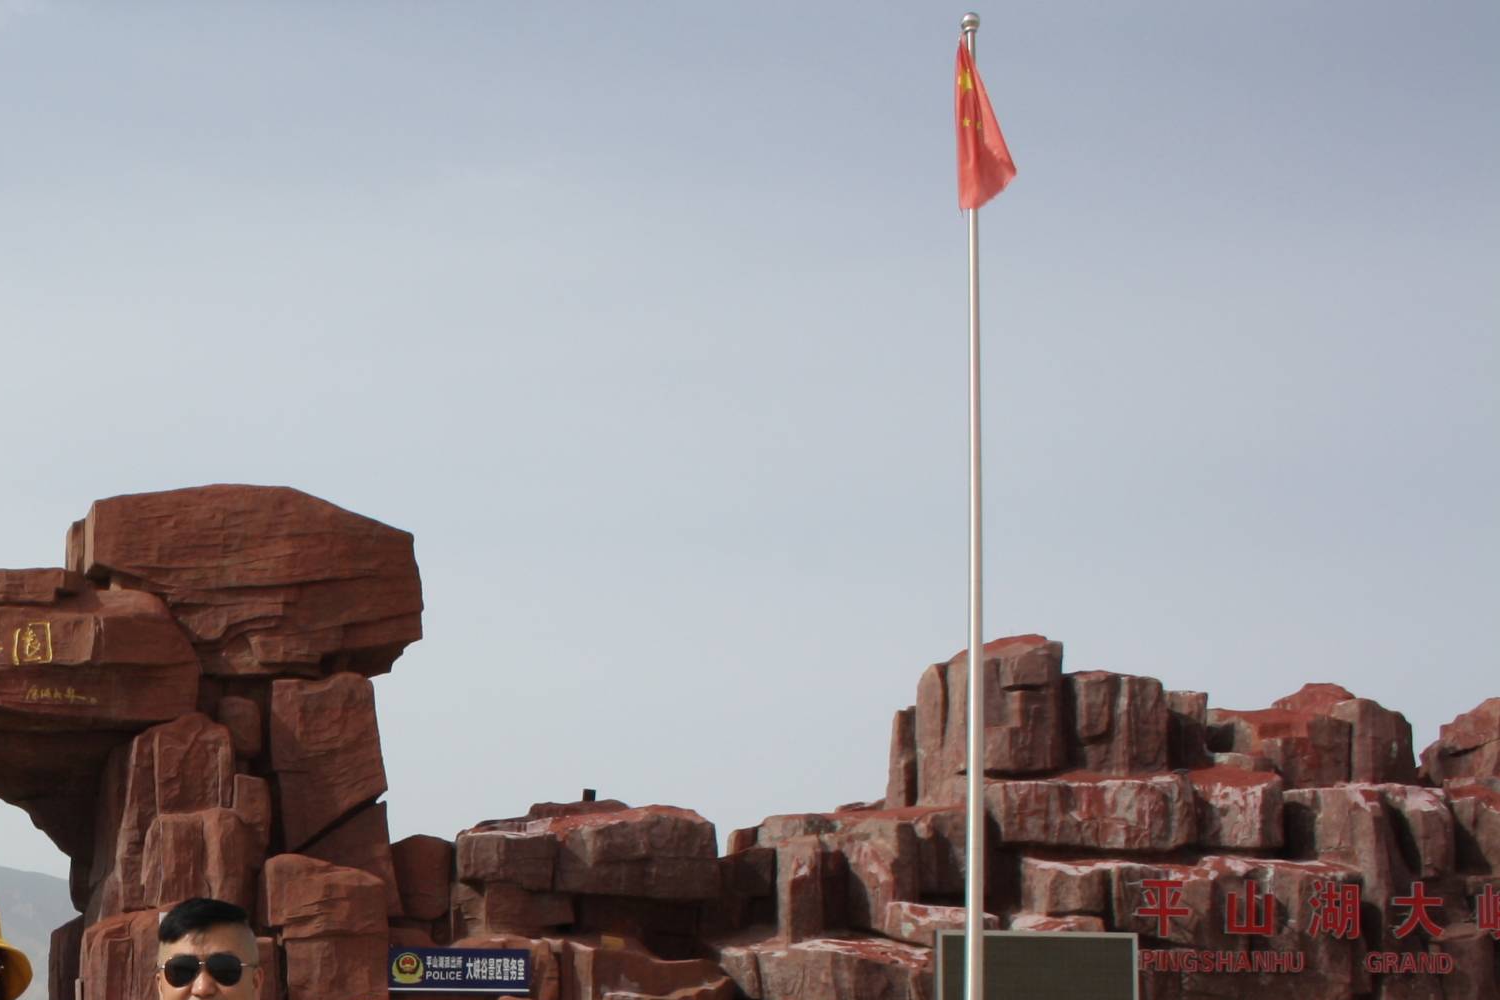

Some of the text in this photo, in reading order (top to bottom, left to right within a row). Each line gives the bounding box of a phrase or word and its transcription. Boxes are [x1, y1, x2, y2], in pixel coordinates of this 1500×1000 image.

[1139, 950, 1453, 975] PINGSHANHU GRAND
[425, 970, 462, 981] POLICE
